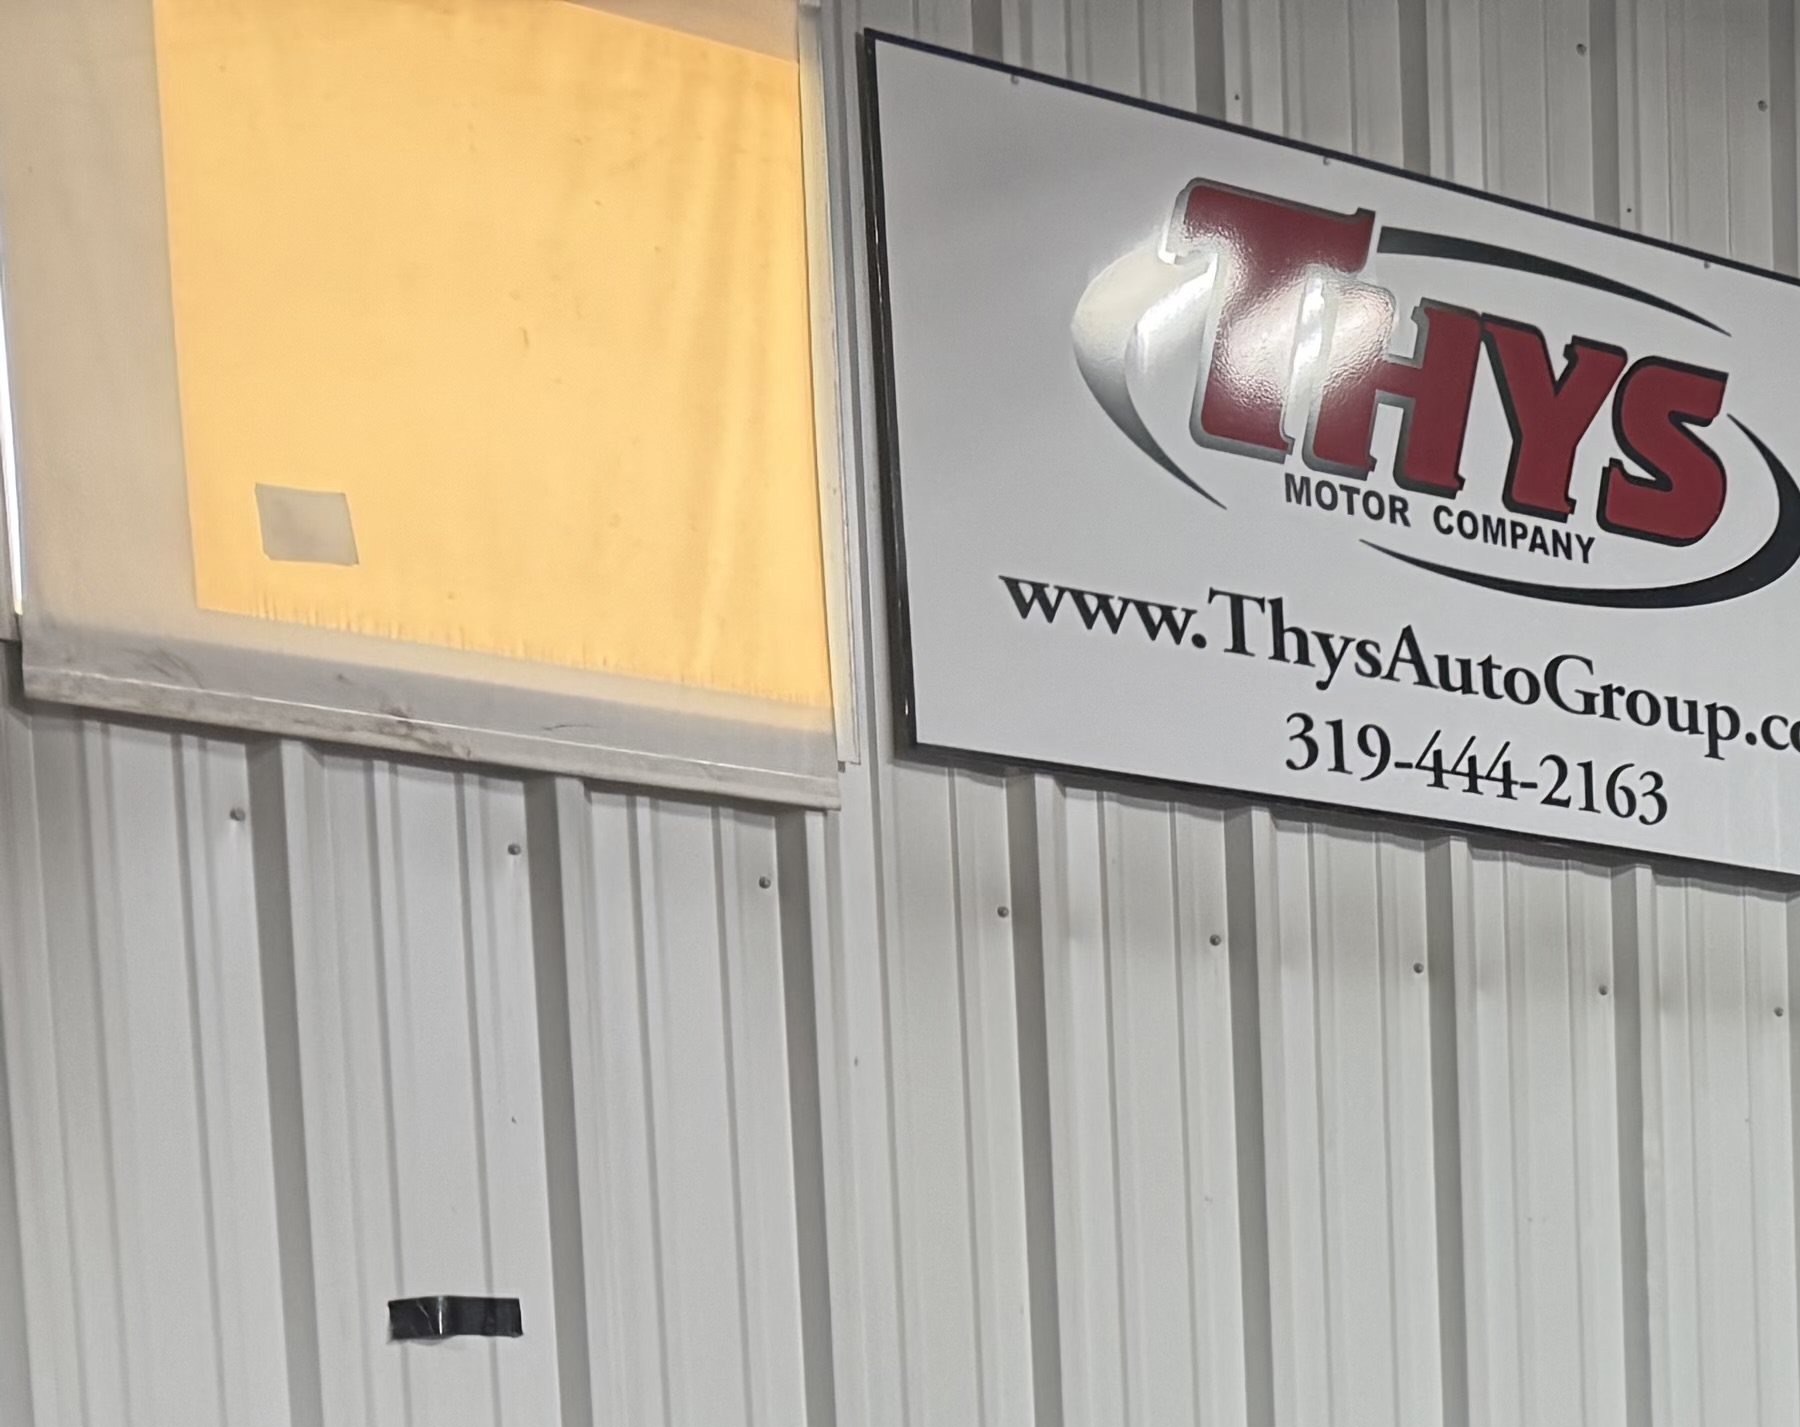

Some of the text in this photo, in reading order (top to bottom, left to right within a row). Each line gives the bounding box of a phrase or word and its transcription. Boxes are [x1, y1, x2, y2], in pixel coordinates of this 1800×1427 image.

[1158, 177, 1730, 547] THYS
[1284, 472, 1597, 565] MOTOR COMPANY
[1286, 712, 1670, 827] 319-444-2163
